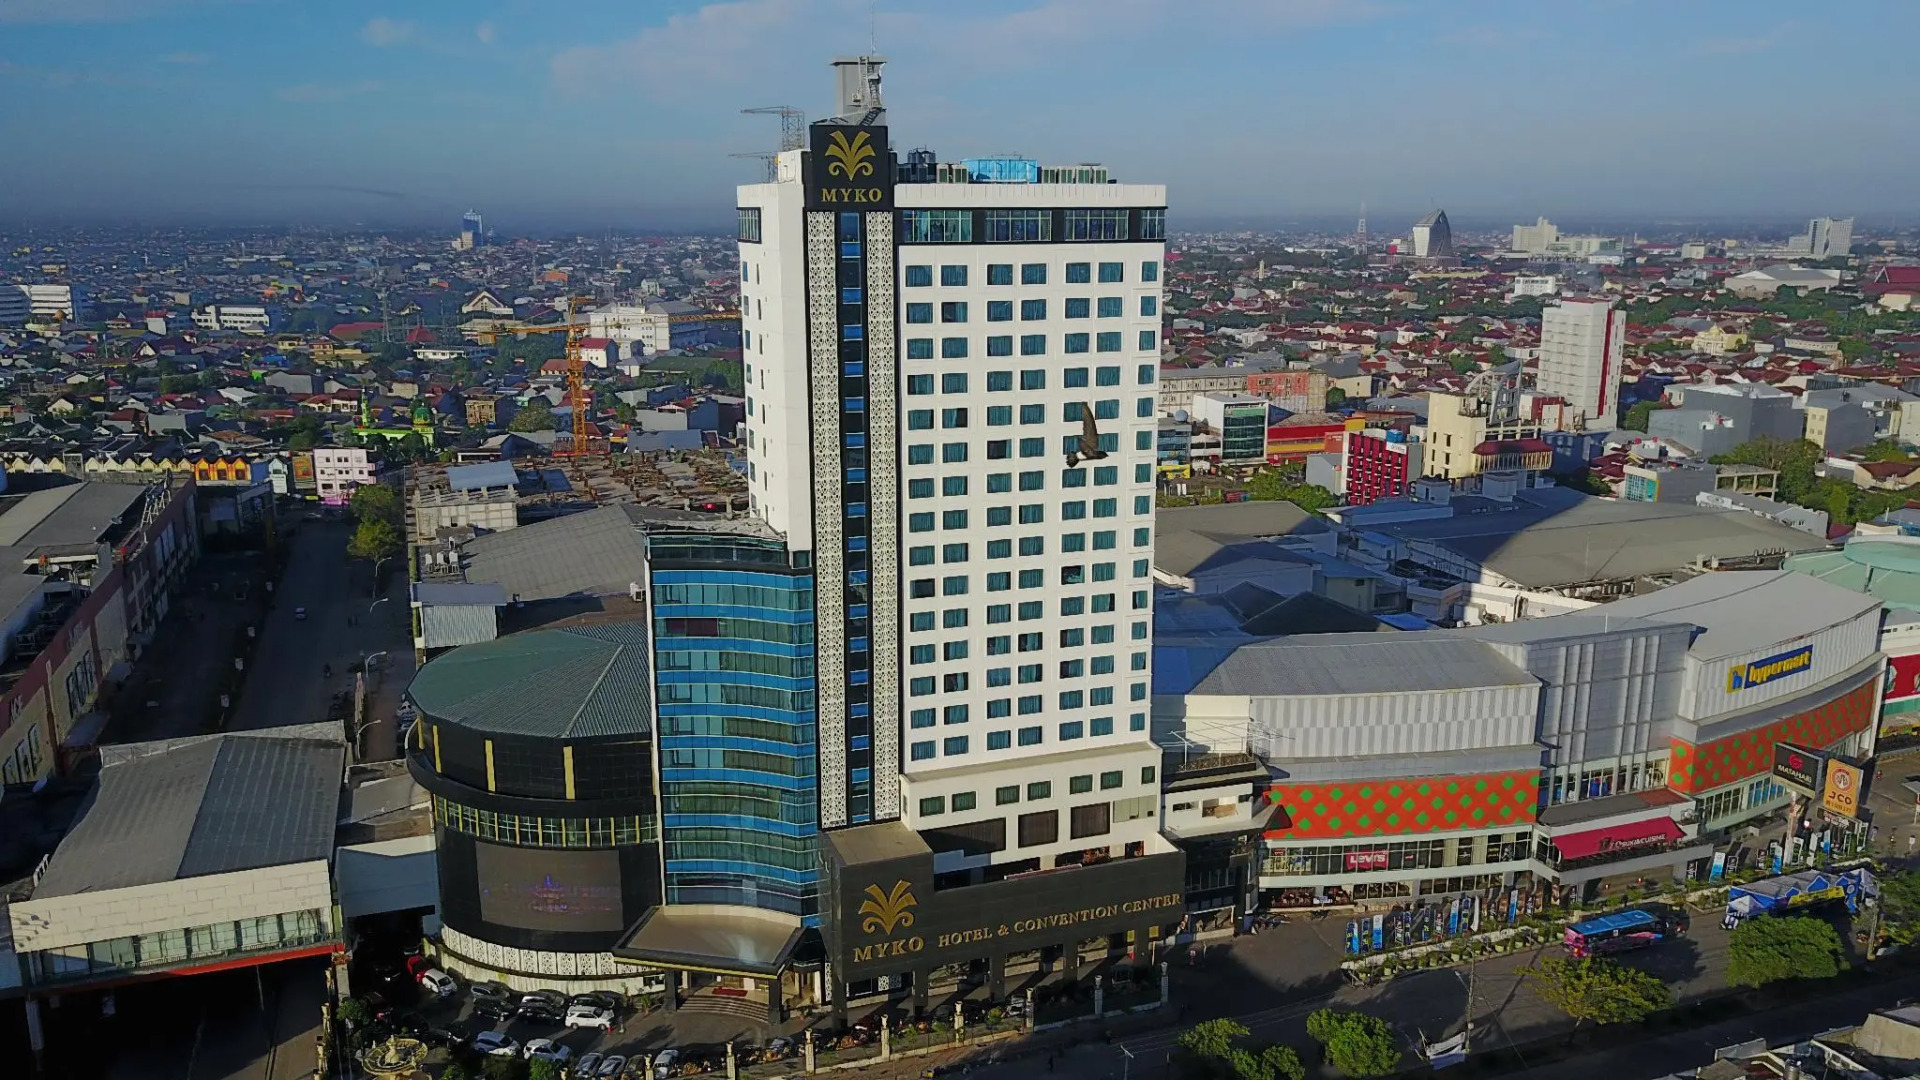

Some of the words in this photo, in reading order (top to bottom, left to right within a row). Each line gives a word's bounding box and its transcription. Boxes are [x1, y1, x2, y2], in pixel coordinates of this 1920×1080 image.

[821, 187, 882, 202] MYKO
[1749, 651, 1811, 684] hypermart
[1777, 764, 1812, 783] MATAHARI
[853, 936, 925, 962] MYKO
[937, 927, 993, 948] HOTEL
[997, 924, 1010, 937] &
[1013, 905, 1118, 934] CONVENTION
[1122, 893, 1182, 915] CENTER
